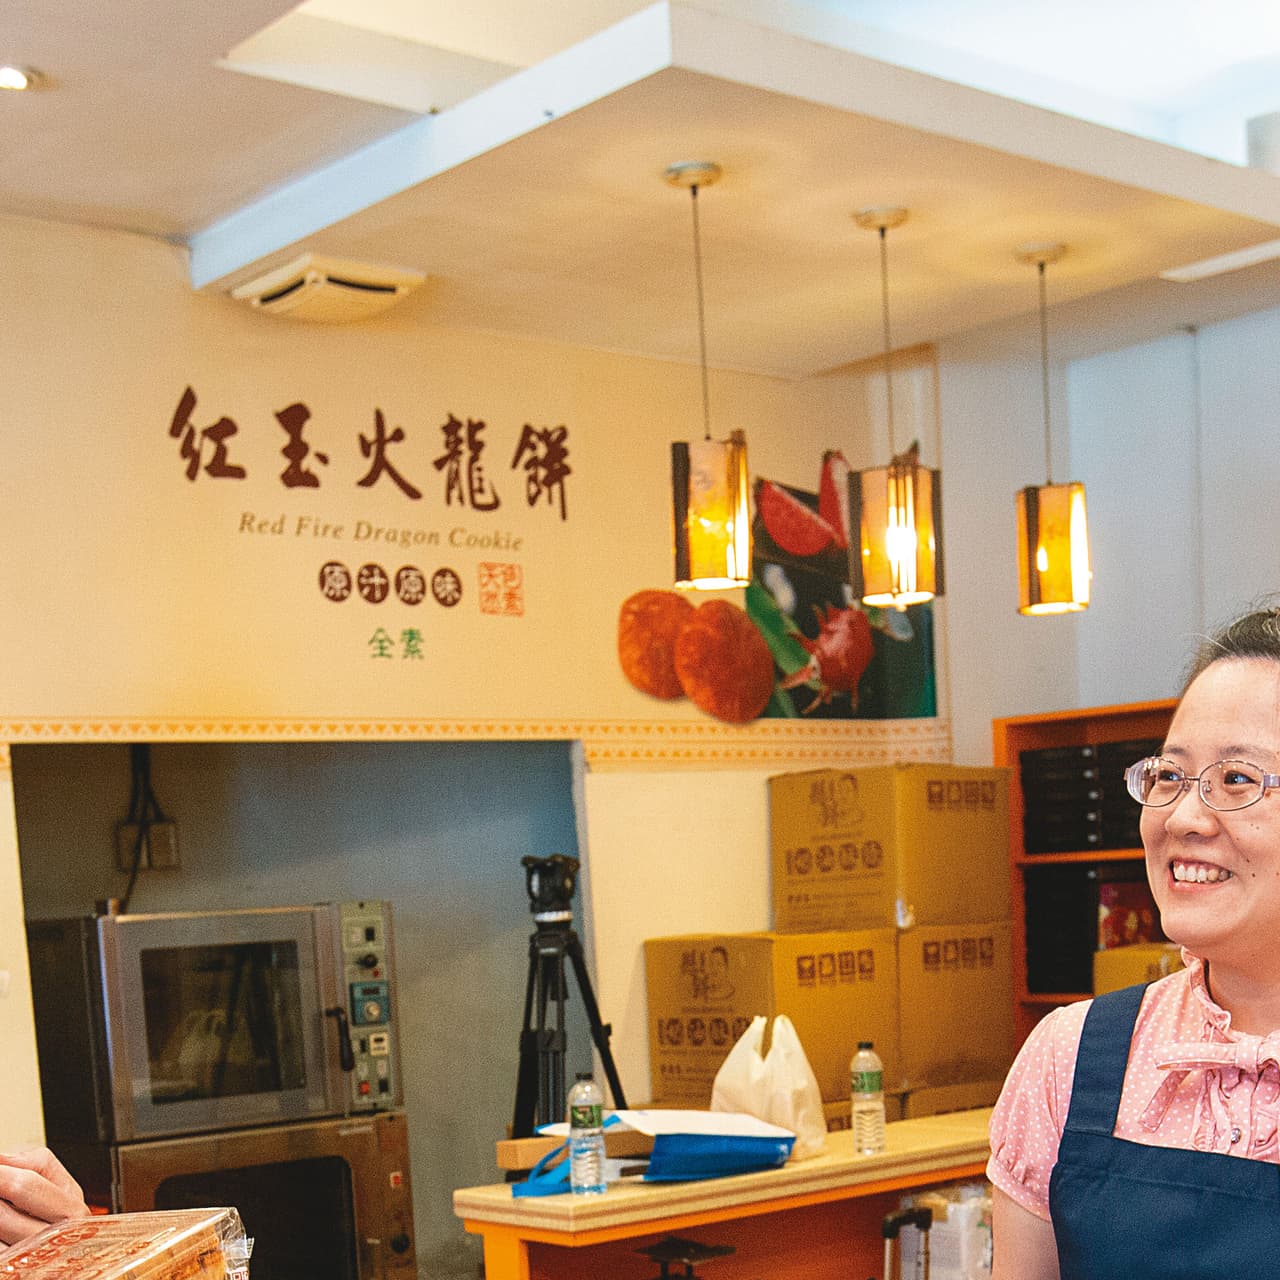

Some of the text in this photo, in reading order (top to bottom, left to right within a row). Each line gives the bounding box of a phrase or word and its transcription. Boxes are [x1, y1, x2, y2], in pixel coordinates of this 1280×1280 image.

[168, 385, 573, 521] 紅玉火龍餅
[238, 511, 524, 552] Red Fire Dragon Cookie
[319, 561, 463, 607] 原汁原味
[369, 627, 425, 660] 全素
